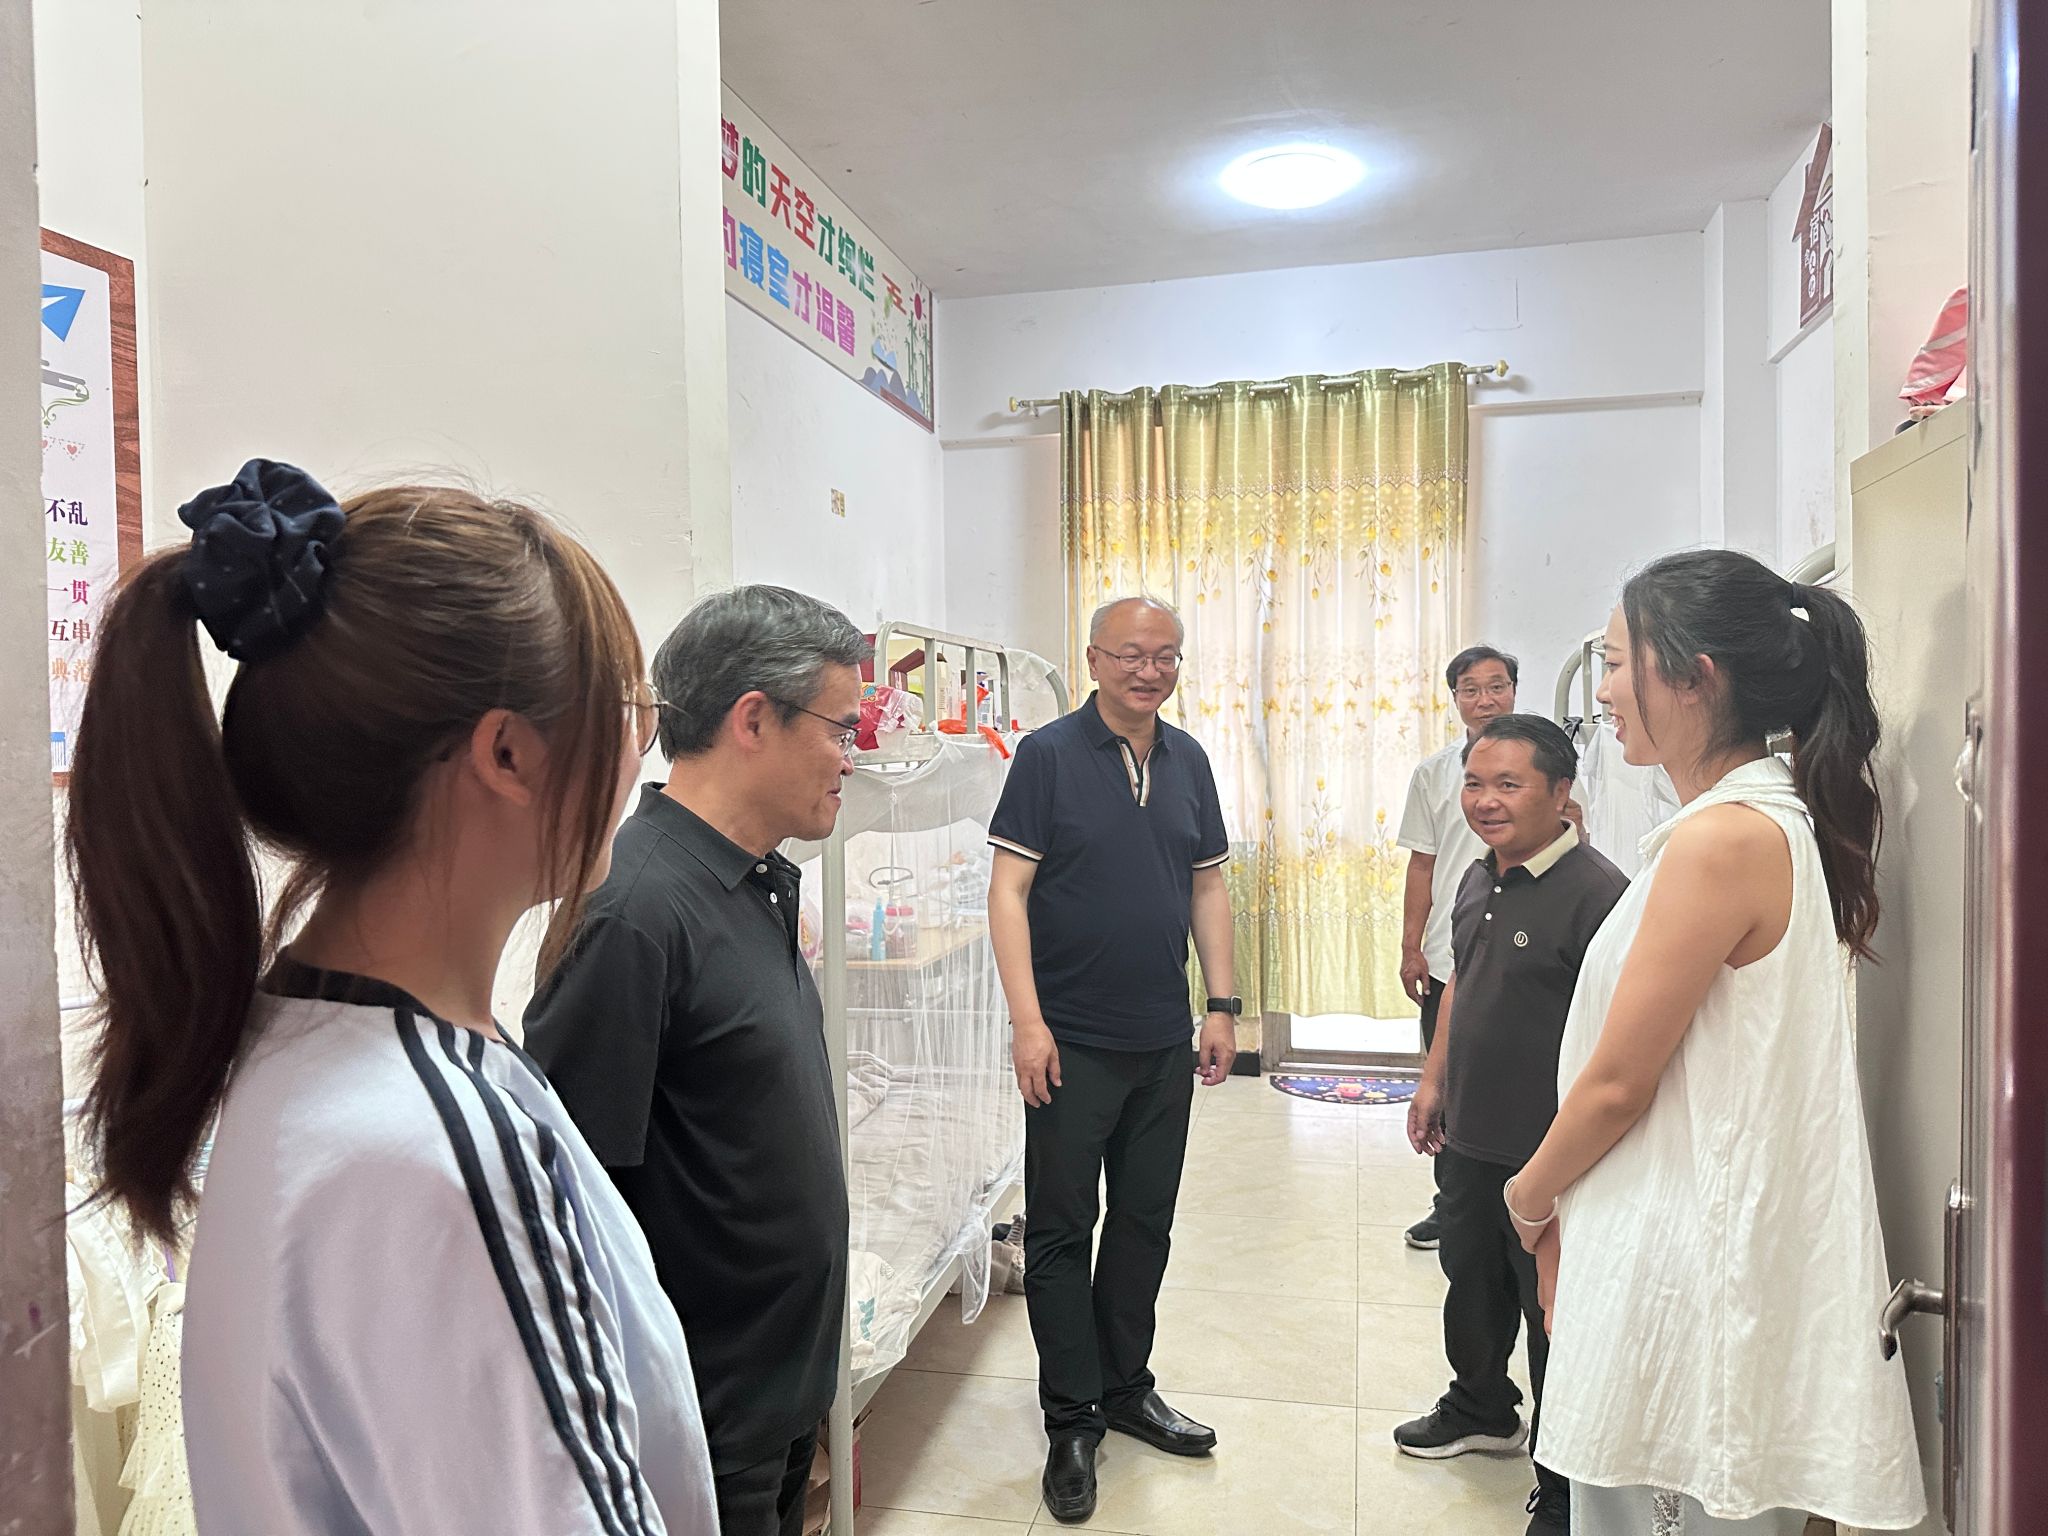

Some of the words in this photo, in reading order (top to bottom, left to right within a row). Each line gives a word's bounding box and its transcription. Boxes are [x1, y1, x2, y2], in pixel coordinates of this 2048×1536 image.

[45, 498, 89, 526] 不乱
[47, 537, 90, 566] 友善
[47, 579, 91, 605] 一贯
